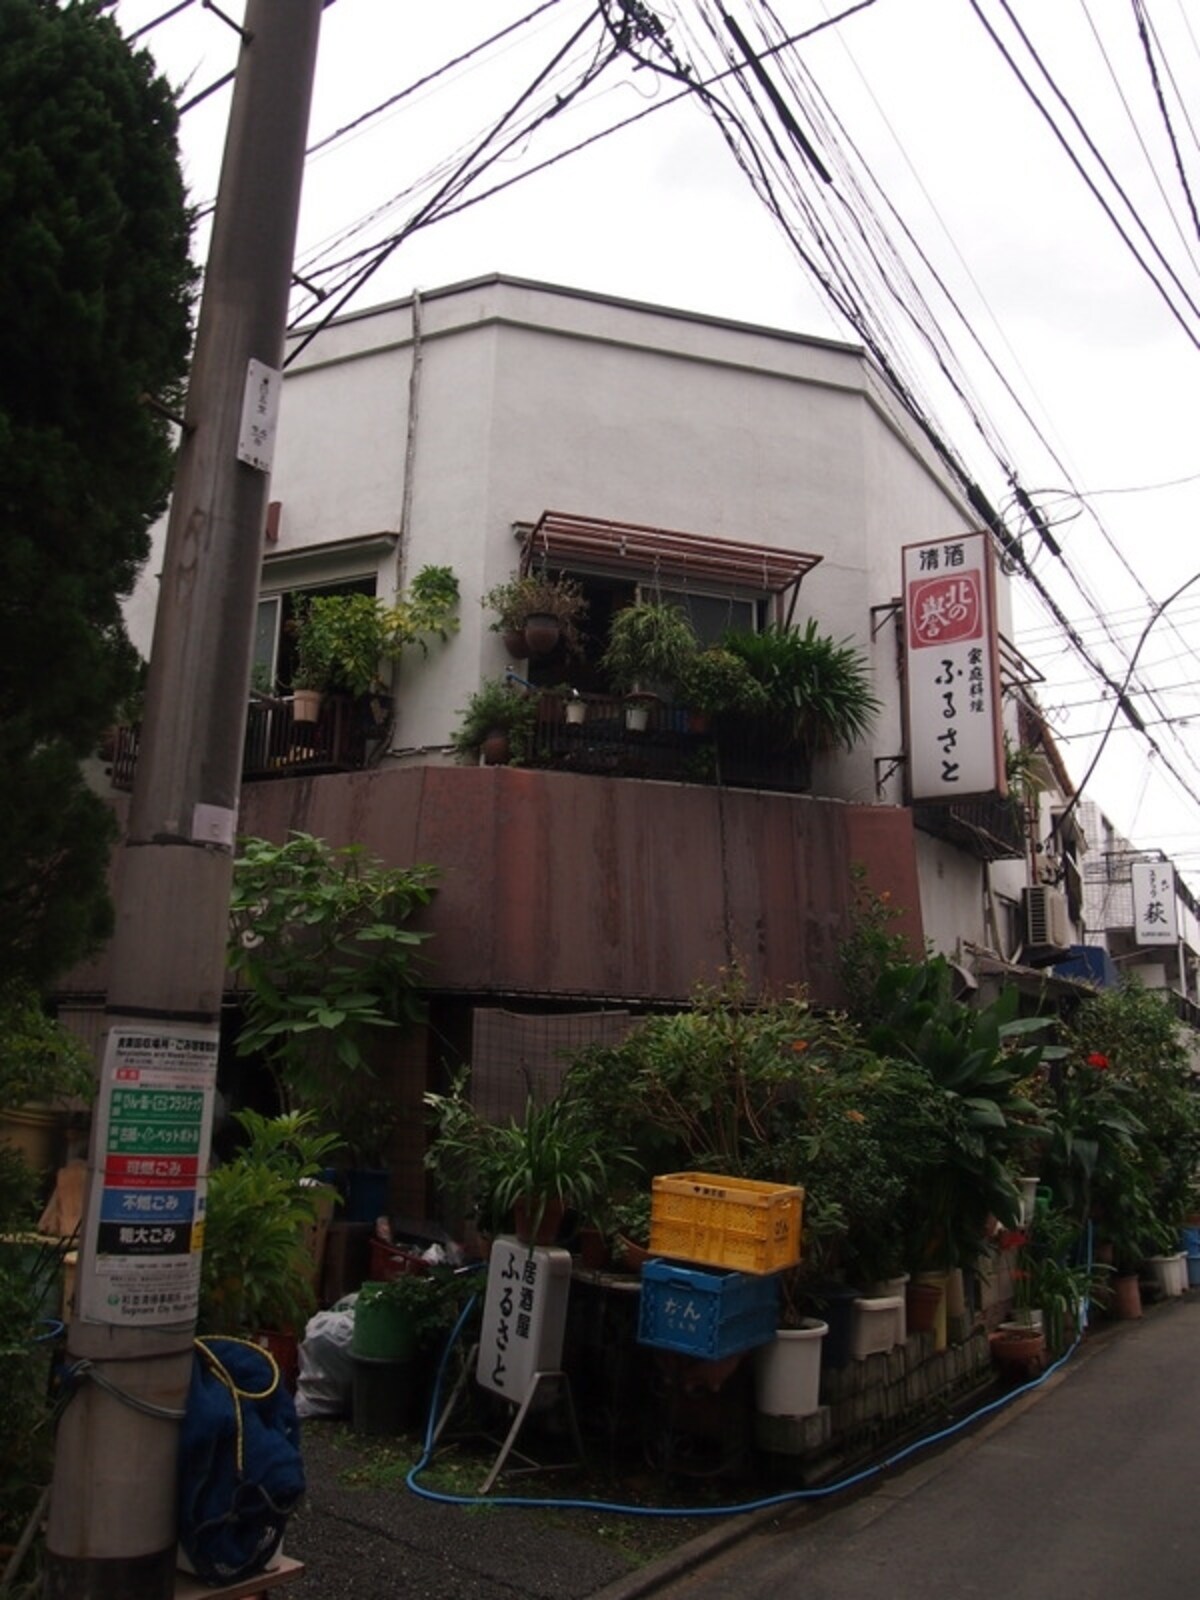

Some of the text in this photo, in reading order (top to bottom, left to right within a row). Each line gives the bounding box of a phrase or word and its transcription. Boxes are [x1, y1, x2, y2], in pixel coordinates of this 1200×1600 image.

[919, 543, 965, 571] 清酒
[967, 647, 985, 713] 家庭料理
[934, 659, 964, 783] ふるさと
[126, 1159, 182, 1176] 可燃ごみ
[122, 1193, 179, 1211] 不燃ごみ
[119, 1226, 177, 1243] 粗大ごみ
[492, 1252, 521, 1387] ふるさと
[515, 1260, 537, 1340] 居酒屋
